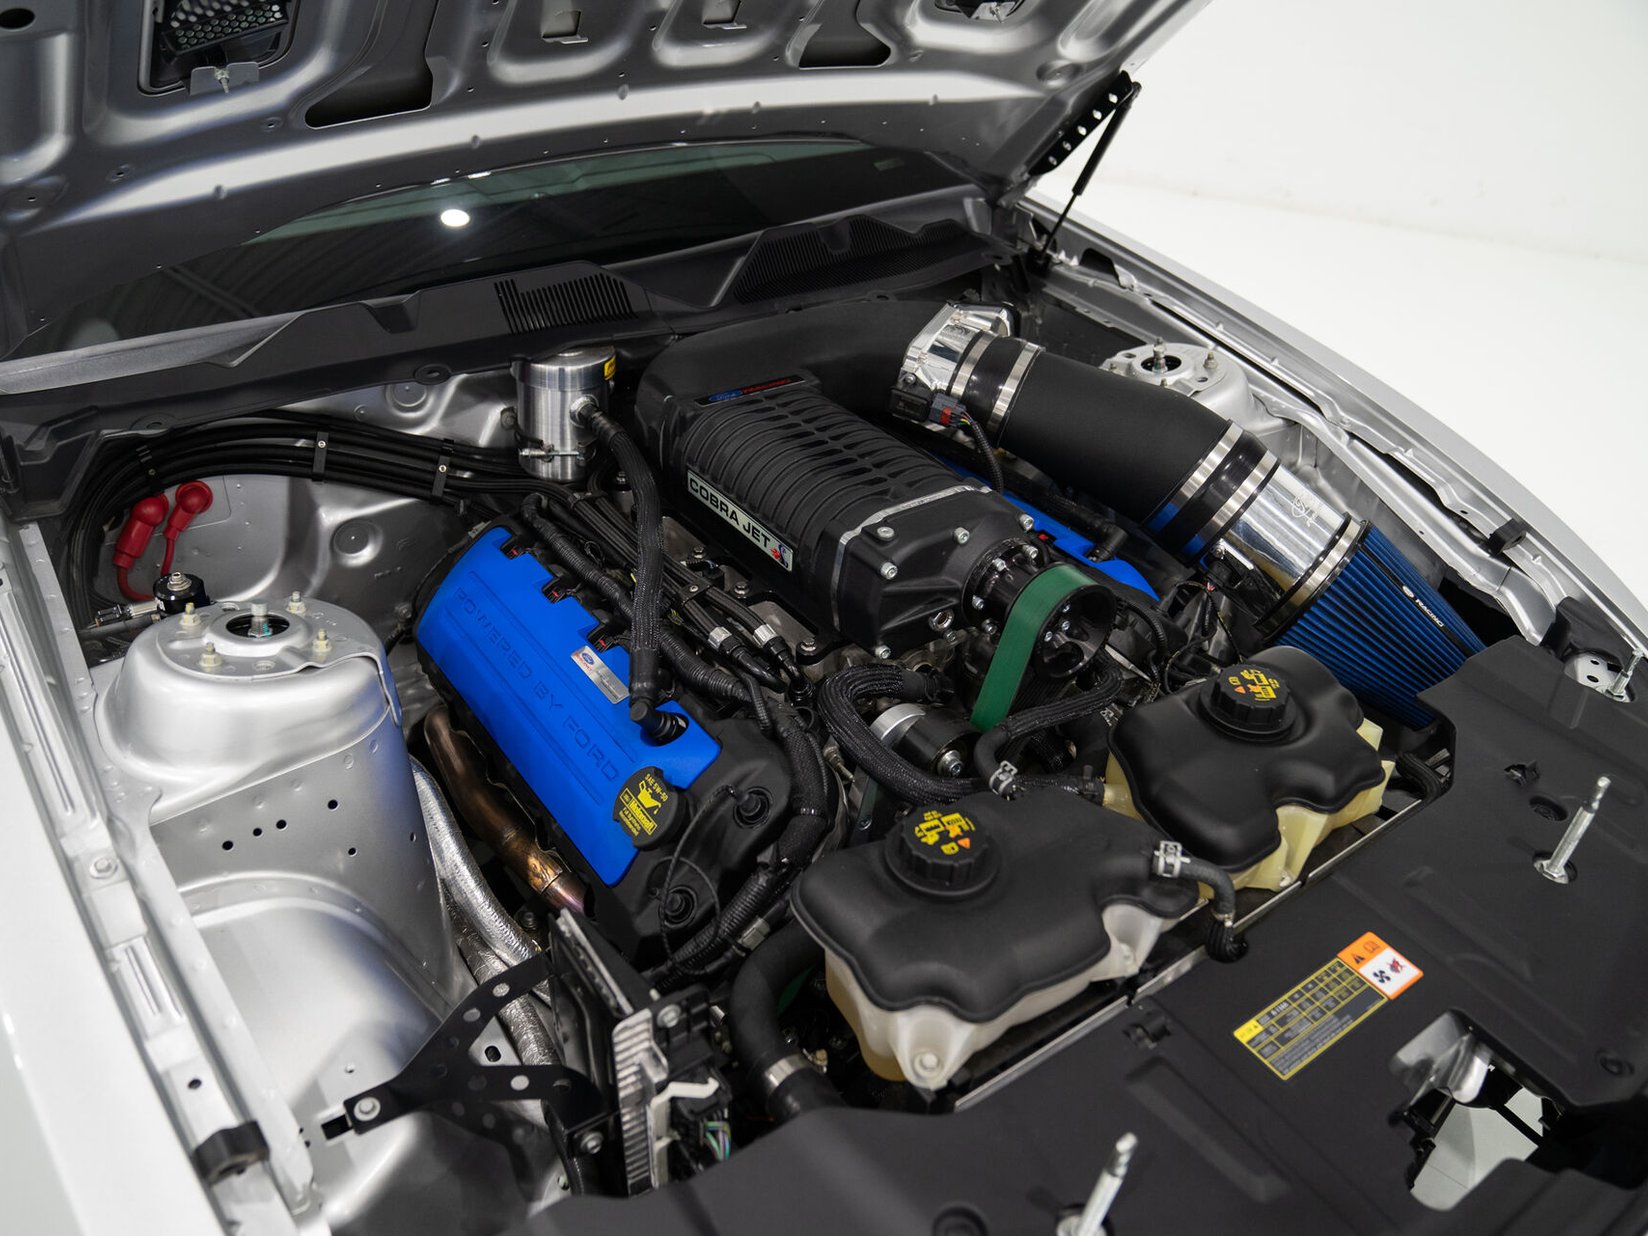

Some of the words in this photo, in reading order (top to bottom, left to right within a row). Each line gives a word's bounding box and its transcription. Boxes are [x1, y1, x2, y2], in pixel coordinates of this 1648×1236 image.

[689, 478, 740, 526] COBRA
[742, 521, 771, 548] JET
[455, 587, 532, 680] POWERED
[533, 681, 564, 710] BY
[562, 715, 619, 782] FORD
